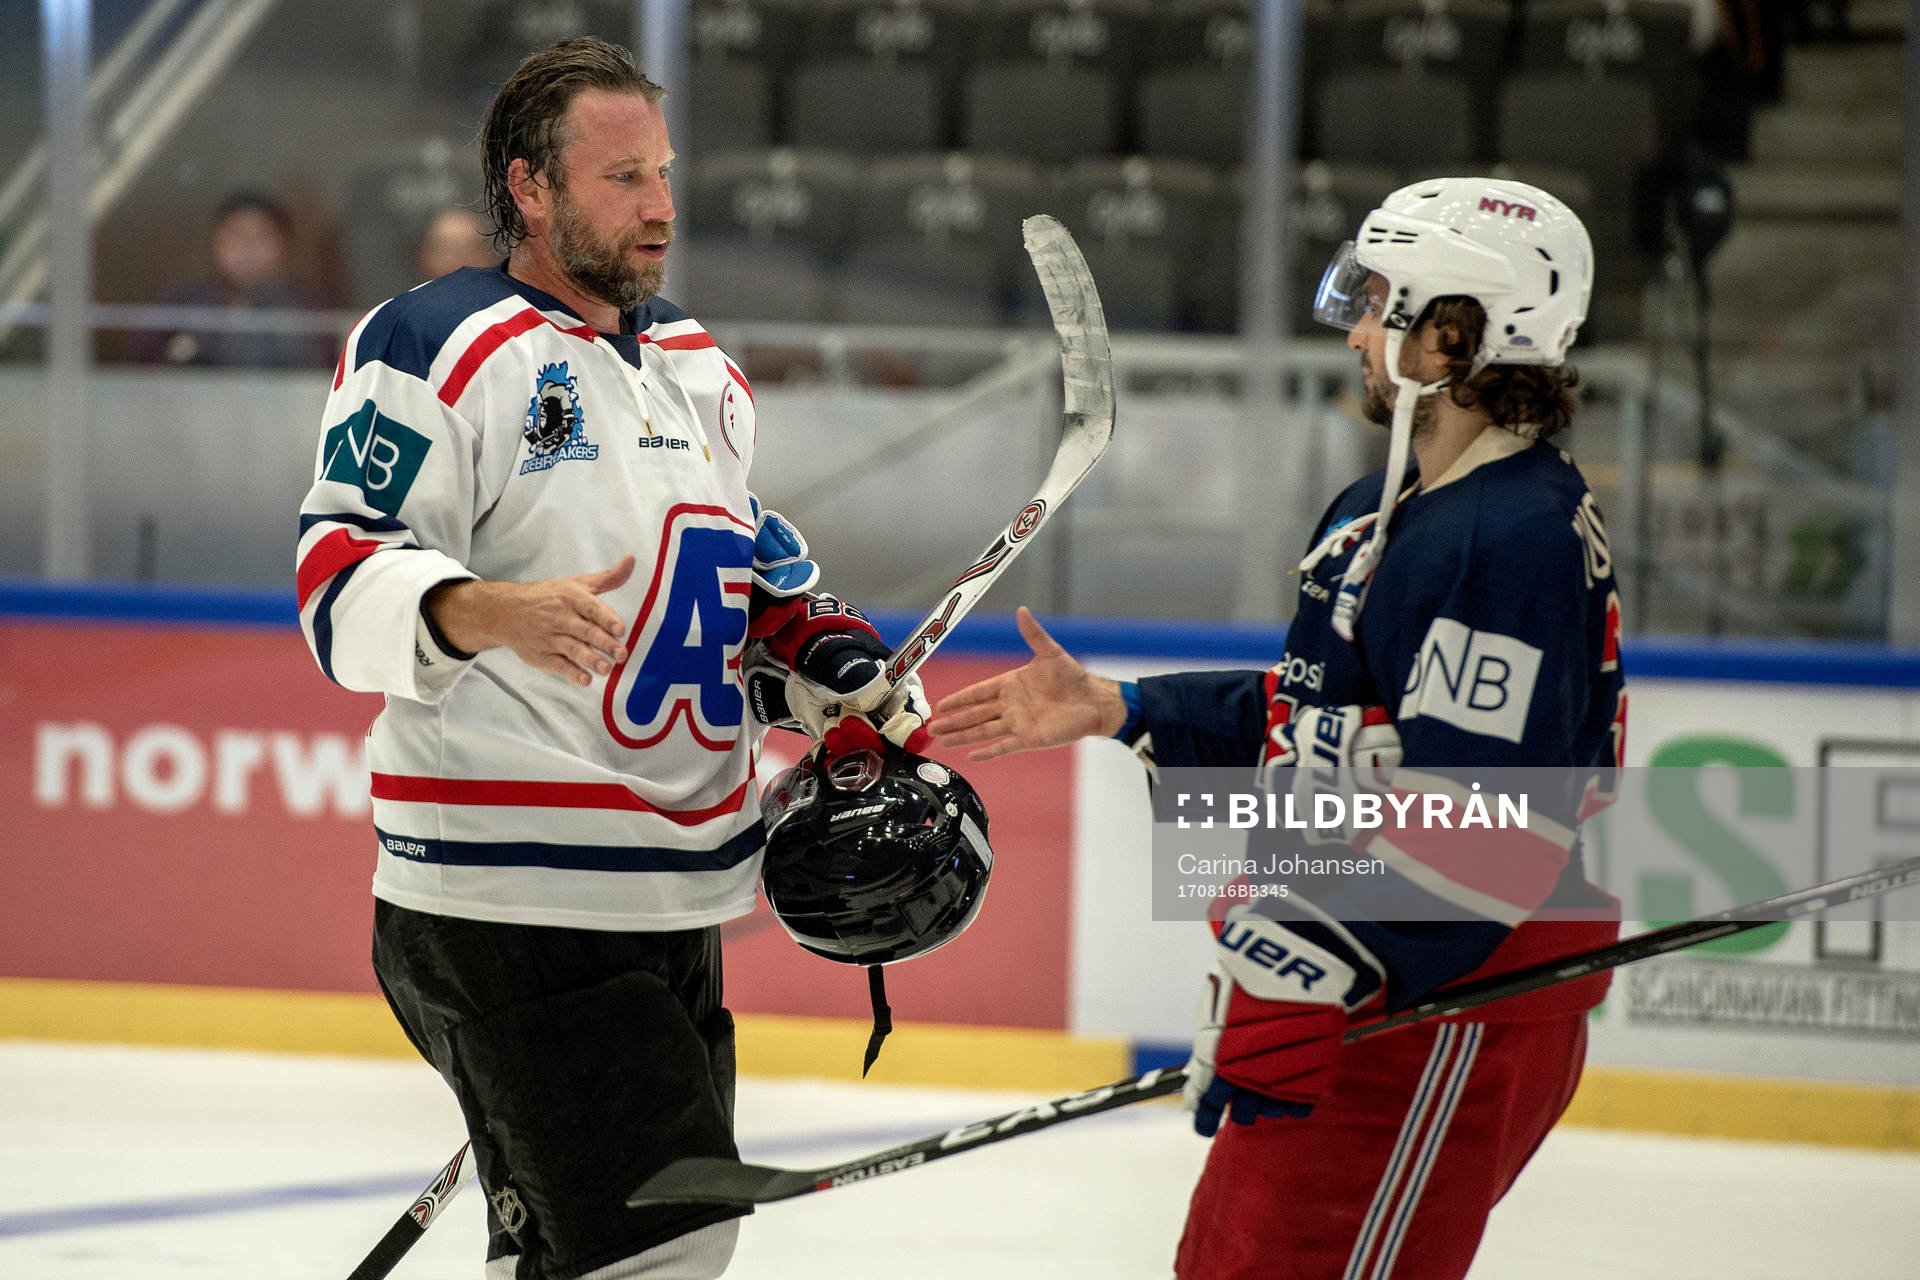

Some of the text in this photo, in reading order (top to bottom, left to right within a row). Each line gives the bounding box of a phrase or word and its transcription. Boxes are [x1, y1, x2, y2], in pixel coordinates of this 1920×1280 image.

[1478, 197, 1537, 222] NYR
[751, 678, 763, 724] BAUER
[829, 803, 887, 823] BAUER
[386, 837, 427, 858] BAUER
[831, 1151, 925, 1189] EASTON
